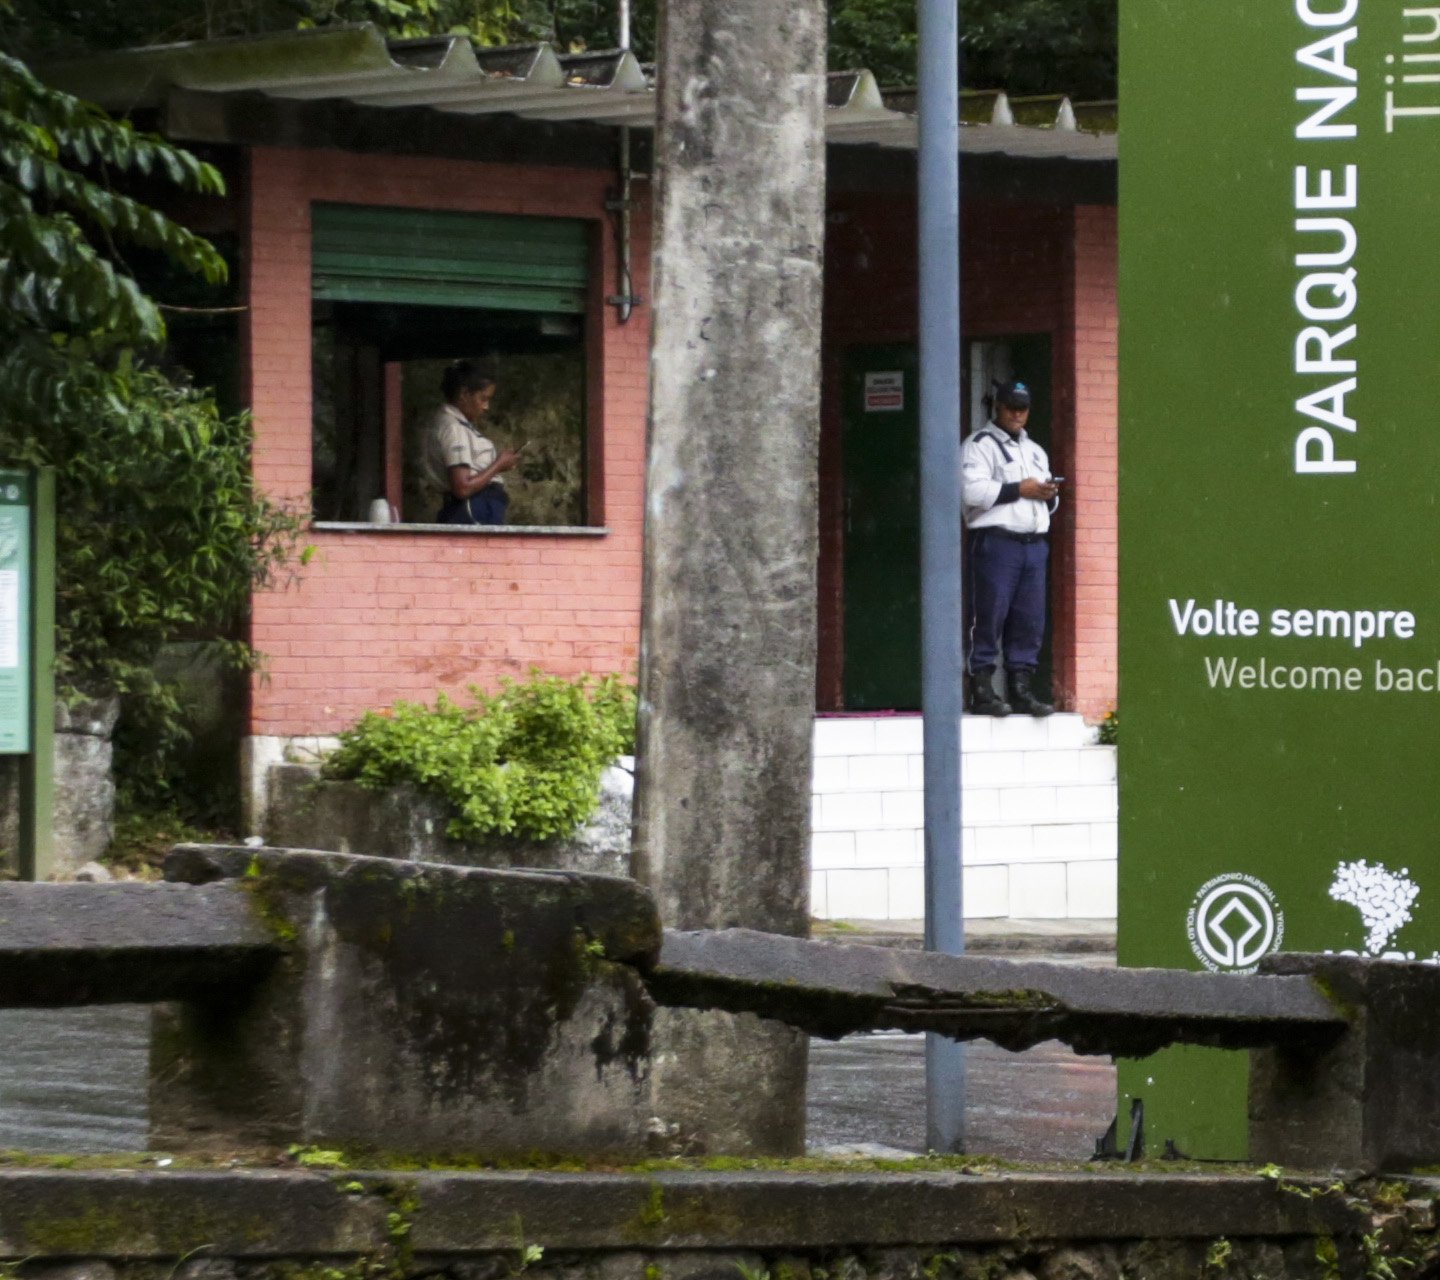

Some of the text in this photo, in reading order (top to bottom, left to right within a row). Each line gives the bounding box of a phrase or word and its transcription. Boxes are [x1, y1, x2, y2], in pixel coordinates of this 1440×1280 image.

[1295, 164, 1358, 474] PARQUE
[1169, 599, 1416, 648] Volte sempre
[1205, 657, 1363, 690] Welcome
